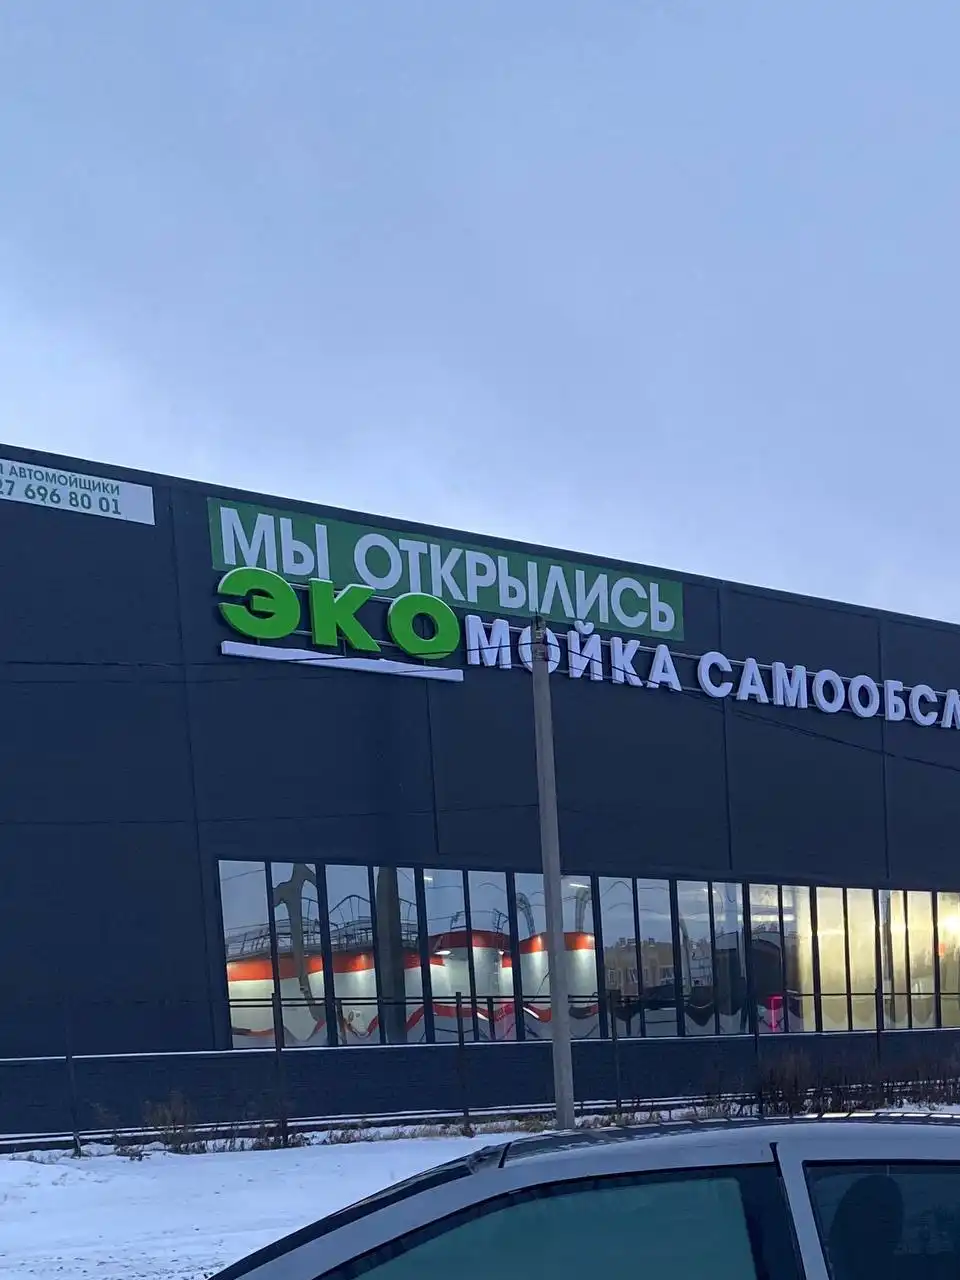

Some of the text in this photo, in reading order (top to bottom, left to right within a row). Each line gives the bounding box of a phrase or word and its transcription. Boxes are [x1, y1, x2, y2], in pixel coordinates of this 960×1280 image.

[9, 464, 120, 496] АВТОМОЙЩИКИ
[24, 483, 61, 504] 696
[68, 491, 92, 510] 80
[98, 496, 122, 516] 01
[219, 506, 676, 632] МЫ ОТКРЫЛИСЬ
